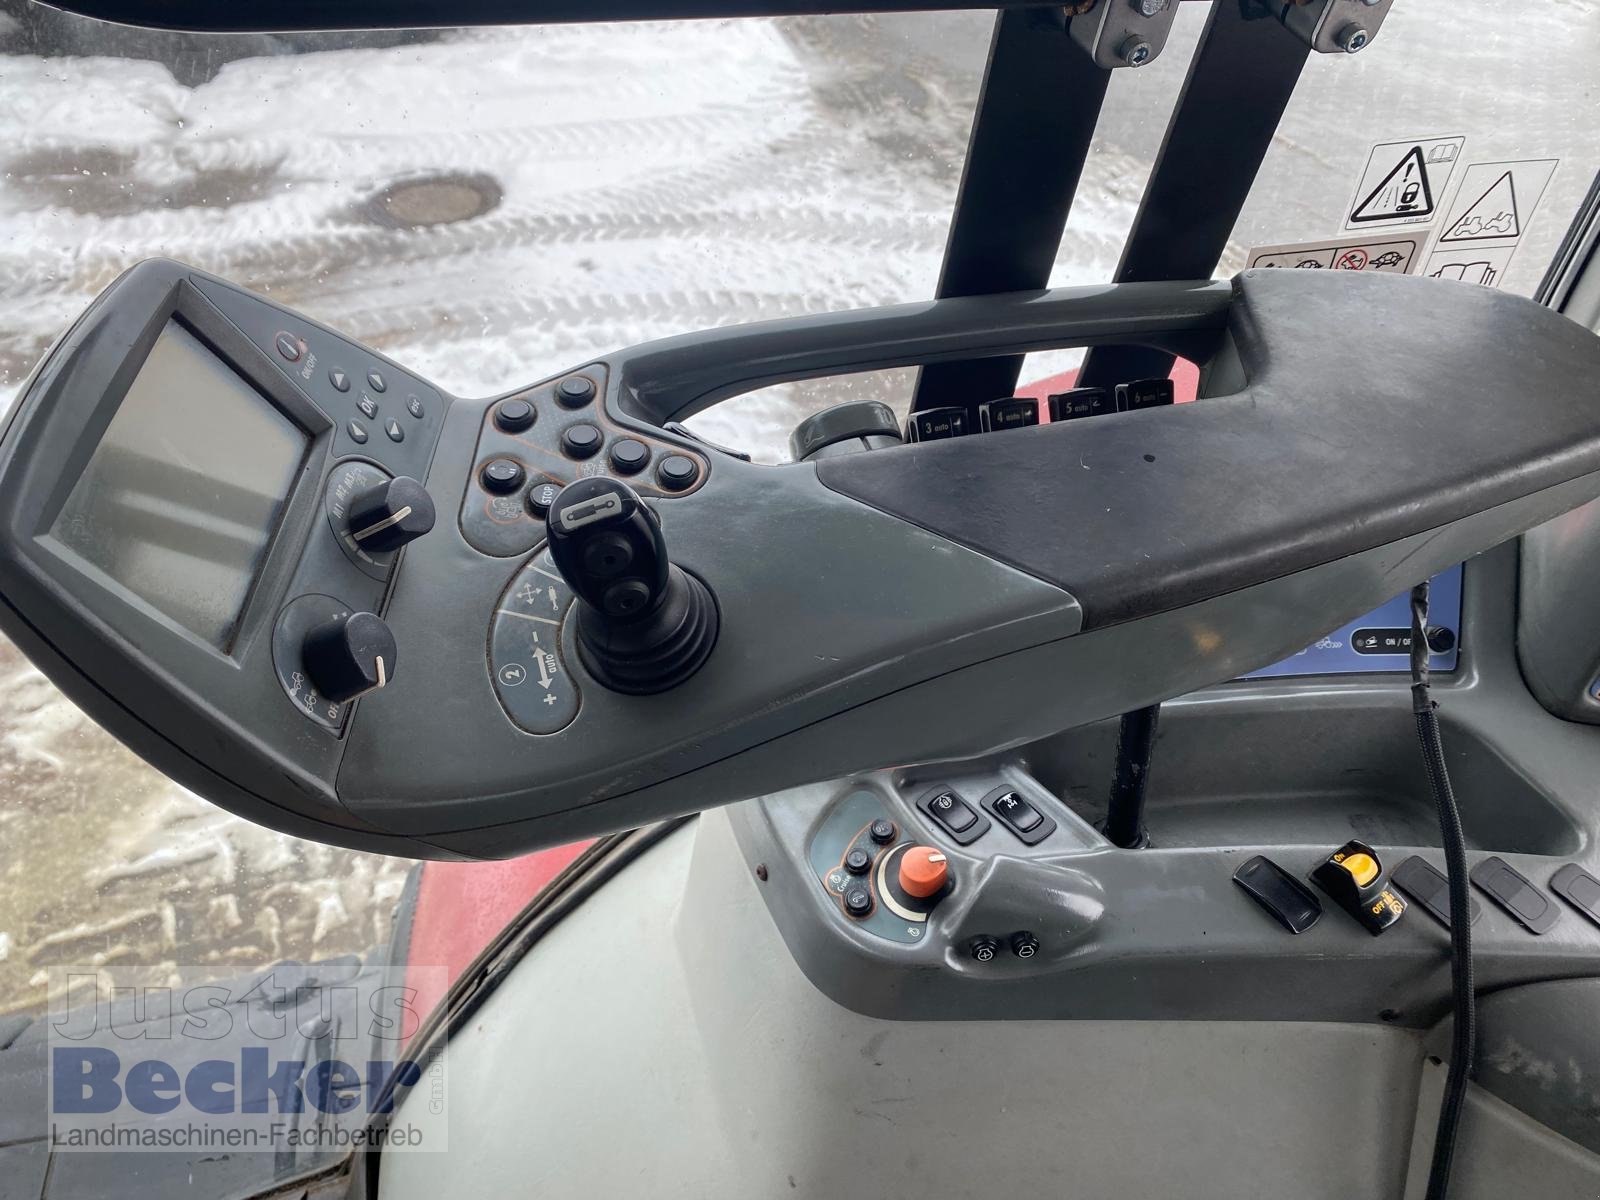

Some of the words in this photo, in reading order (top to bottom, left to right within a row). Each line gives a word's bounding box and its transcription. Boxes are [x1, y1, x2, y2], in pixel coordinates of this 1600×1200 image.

[302, 353, 318, 380] ON/OFF
[361, 395, 376, 414] OK
[1066, 401, 1073, 414] 5
[1074, 404, 1089, 412] auto
[997, 411, 1004, 423] 4
[1006, 413, 1021, 422] auto
[925, 422, 933, 434] 3
[934, 424, 949, 432] auto
[335, 484, 348, 501] M2
[541, 486, 554, 505] STOP
[332, 503, 345, 519] M1
[1385, 638, 1396, 647] ON
[545, 653, 557, 673] auto
[505, 669, 520, 680] 2
[1372, 899, 1386, 915] OFF
